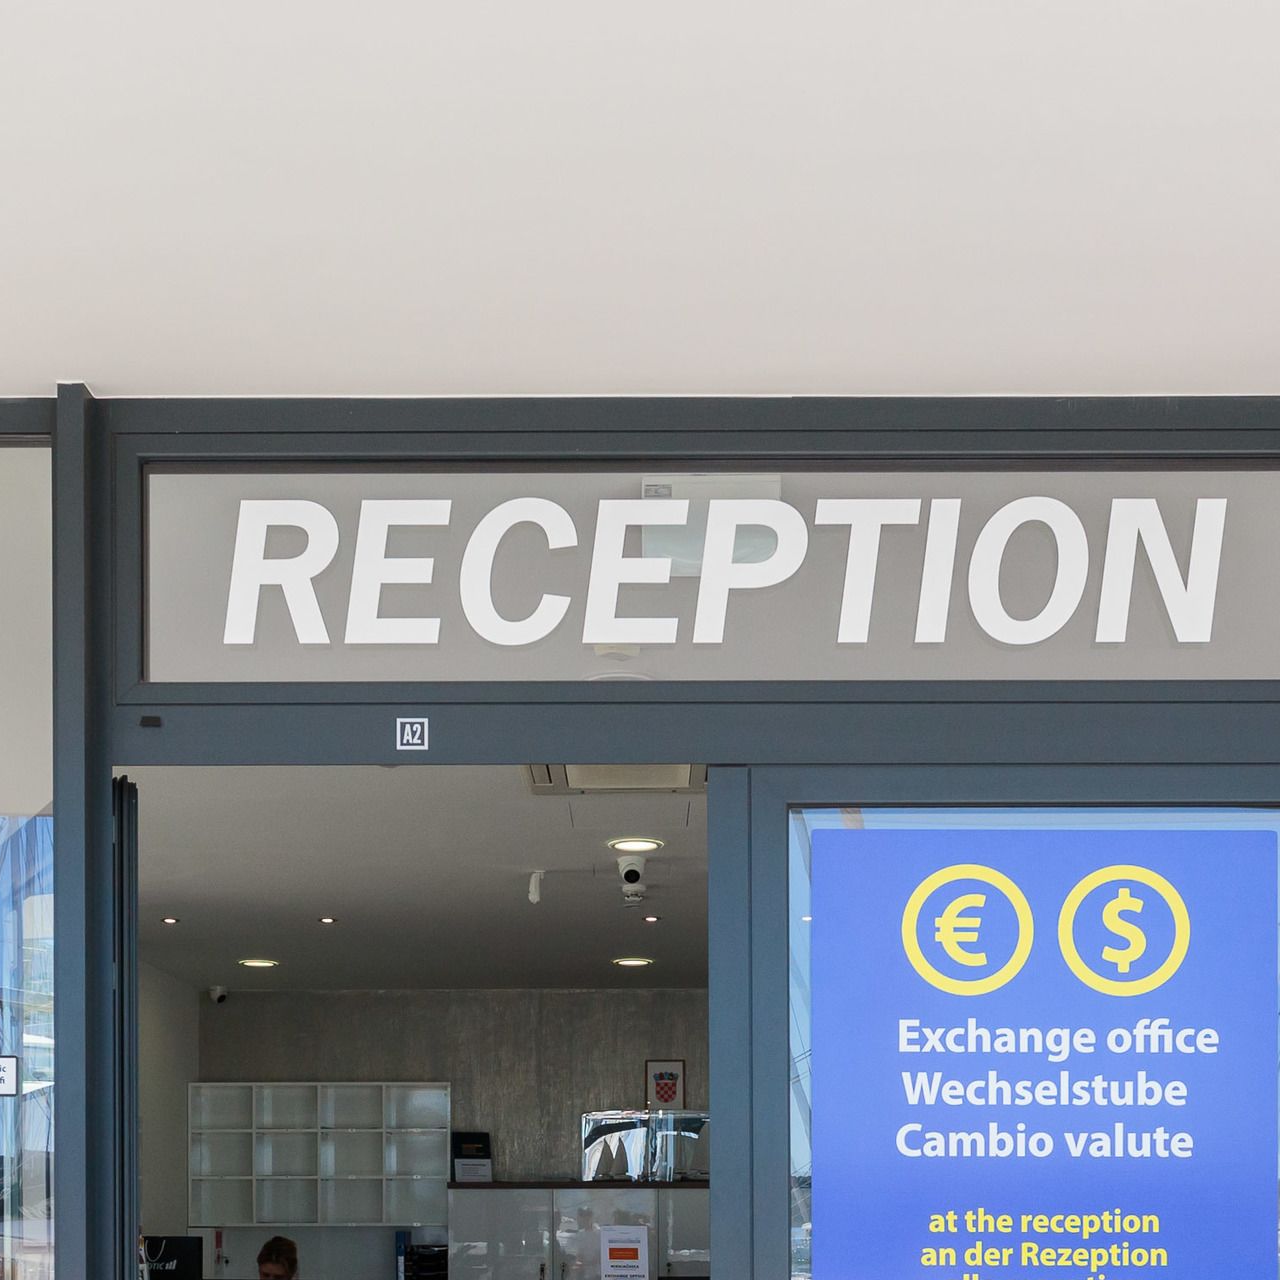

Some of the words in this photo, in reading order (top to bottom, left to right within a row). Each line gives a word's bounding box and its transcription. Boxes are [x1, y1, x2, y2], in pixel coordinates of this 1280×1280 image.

[224, 497, 1227, 645] RECEPTION
[402, 723, 422, 744] A2
[898, 1017, 1097, 1062] Exchange
[1107, 1018, 1220, 1054] office
[902, 1070, 1188, 1106] Wechselstube
[895, 1122, 1054, 1158] Cambio
[1064, 1122, 1194, 1158] valute
[929, 1211, 958, 1233] at
[964, 1208, 1014, 1233] the
[1021, 1209, 1160, 1239] reception
[920, 1247, 957, 1266] an
[964, 1241, 1014, 1266] der
[1021, 1242, 1168, 1272] Rezeption
